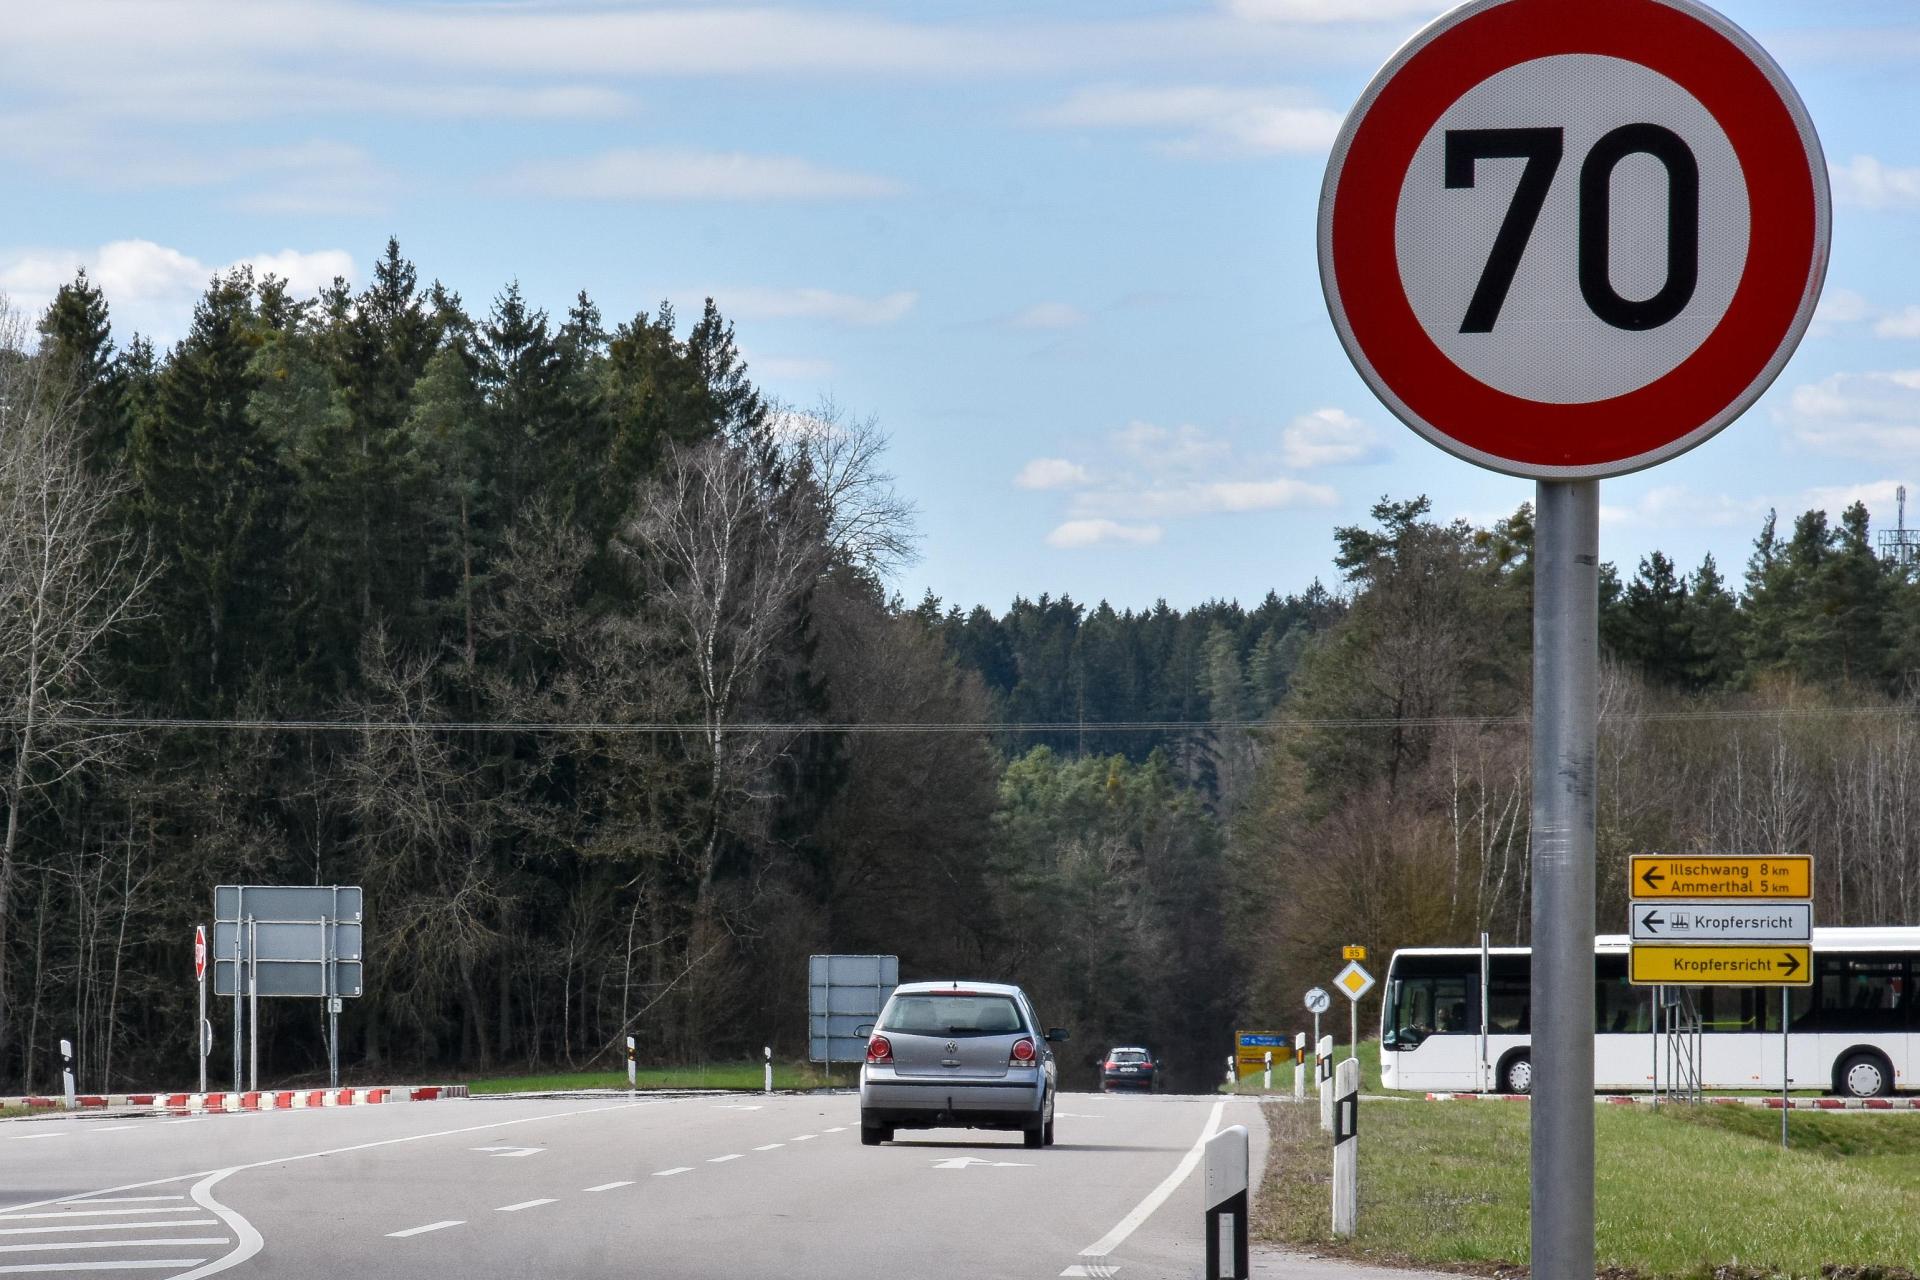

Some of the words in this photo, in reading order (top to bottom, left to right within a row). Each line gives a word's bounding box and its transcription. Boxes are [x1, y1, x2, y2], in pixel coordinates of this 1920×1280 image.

[1445, 122, 1699, 334] 70
[1670, 863, 1749, 878] Illschwang
[1760, 863, 1768, 876] 8
[1772, 866, 1789, 876] km
[1671, 880, 1753, 892] Ammerthal
[1760, 880, 1768, 893] 5
[1772, 883, 1789, 893] km
[1695, 916, 1793, 931] Kropfersricht
[1674, 958, 1771, 973] Kropfersricht
